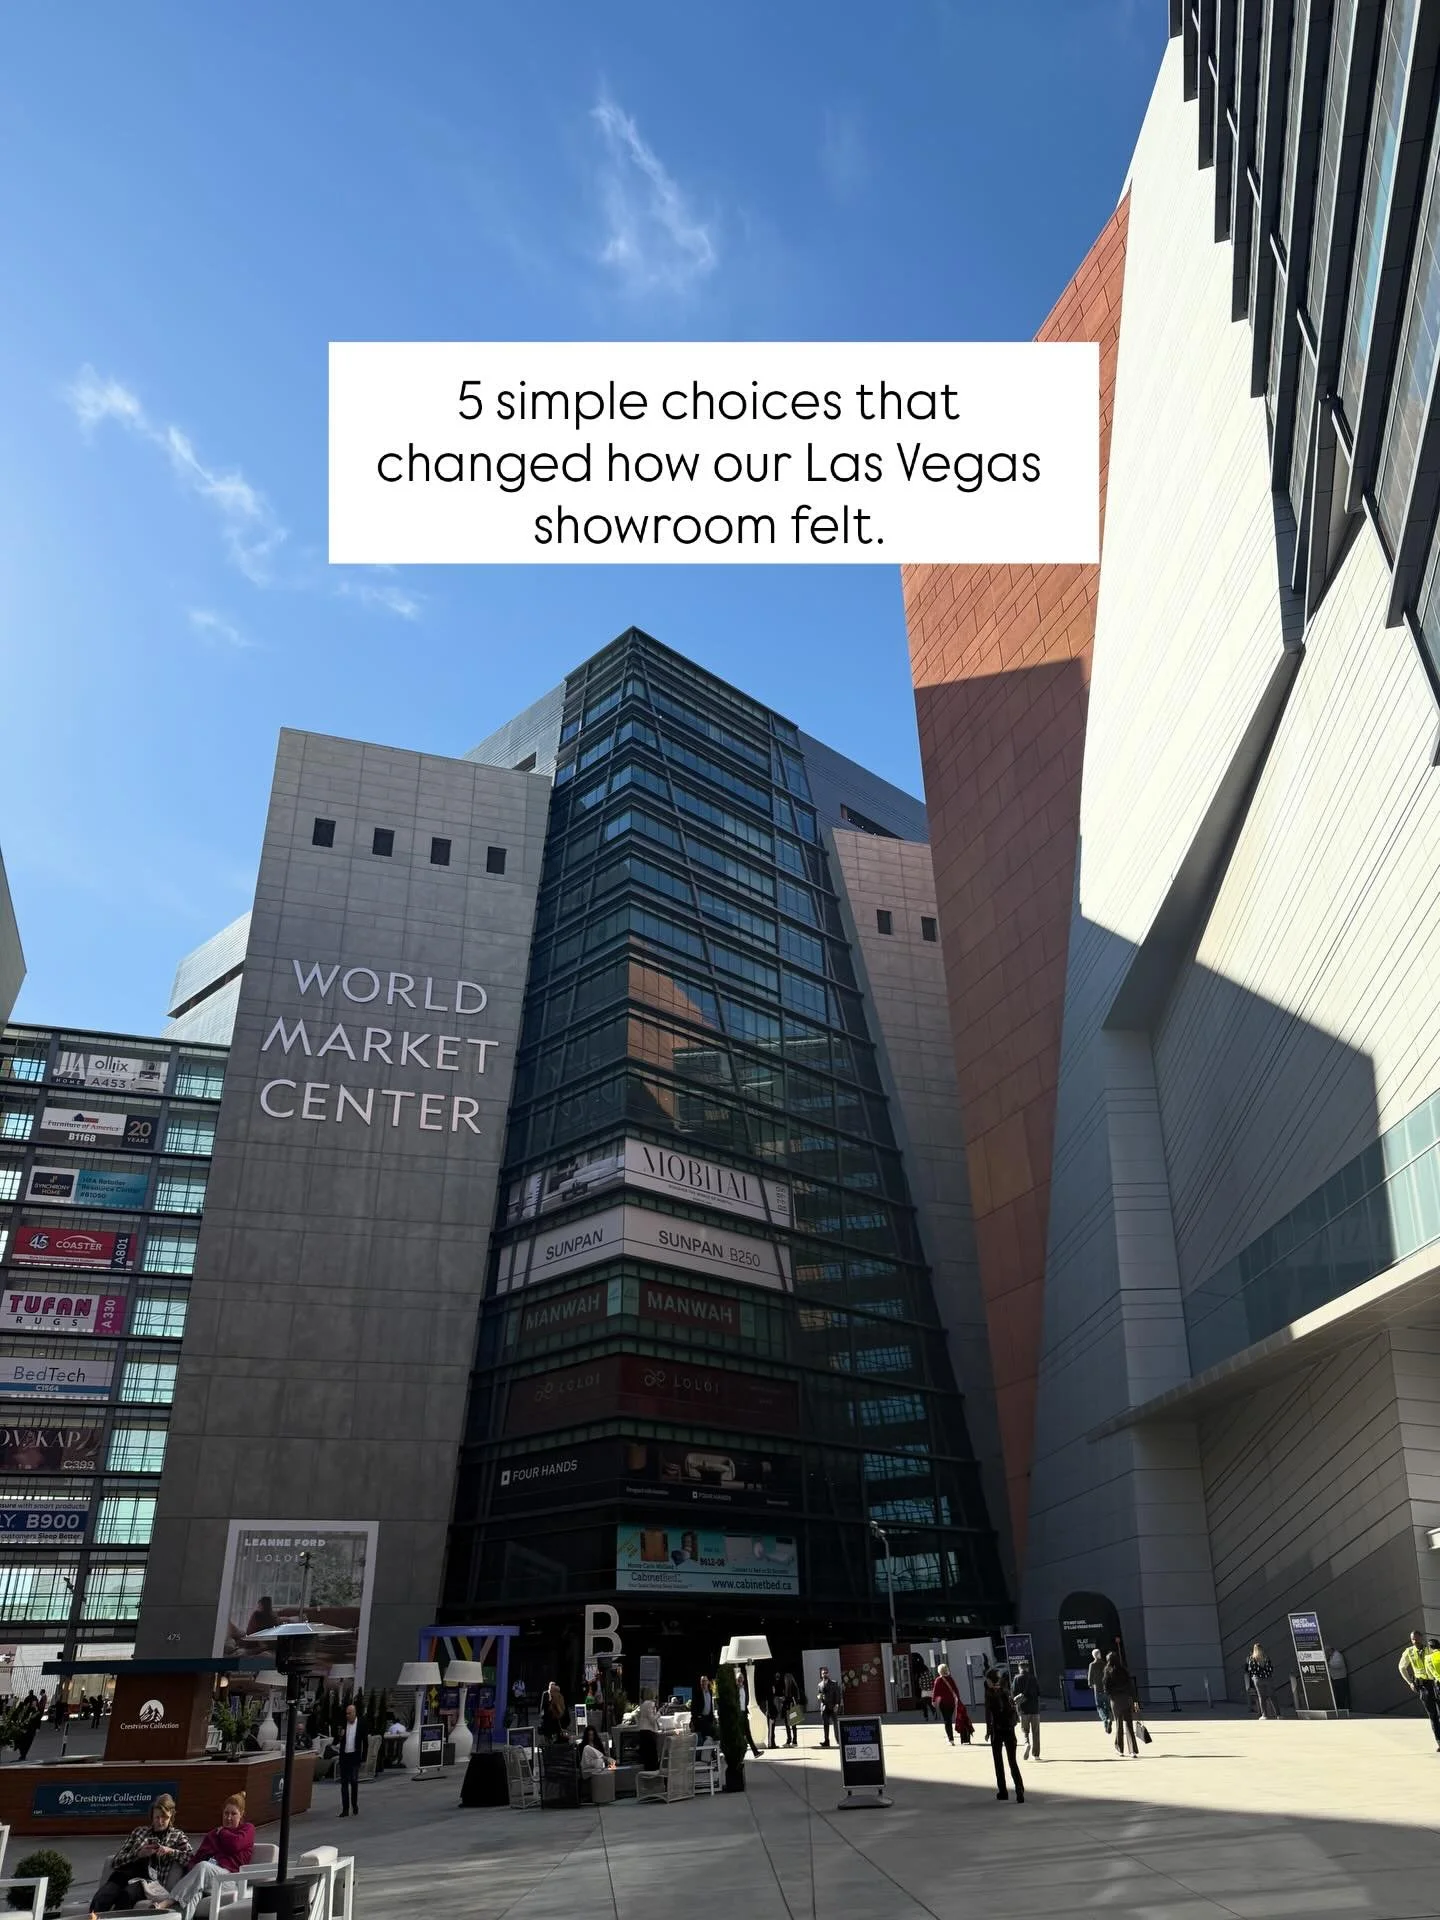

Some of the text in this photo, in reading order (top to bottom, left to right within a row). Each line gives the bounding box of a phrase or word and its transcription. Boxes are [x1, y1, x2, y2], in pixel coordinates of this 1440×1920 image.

[292, 959, 488, 1014] WORLD
[261, 1016, 499, 1074] MARKET
[90, 1077, 126, 1088] A453
[260, 1079, 481, 1134] CENTER
[47, 1120, 80, 1128] Furniture
[91, 1124, 119, 1132] America
[128, 1121, 152, 1137] 20
[68, 1132, 96, 1142] B1168
[33, 1182, 71, 1190] SYNCHRONY
[56, 1240, 102, 1251] COASTER
[114, 1238, 129, 1265] A801
[545, 1228, 604, 1261] SUNPAN
[658, 1230, 761, 1267] SUNPAN B250
[10, 1295, 92, 1316] TUFAN
[526, 1293, 600, 1331] MANWAH
[647, 1291, 733, 1324] MANWAH
[16, 1316, 78, 1327] RUGS
[14, 1366, 86, 1382] BedTech
[673, 1375, 719, 1395] LOLOI
[63, 1460, 95, 1469] C399
[512, 1459, 579, 1482] FOUR HANDS
[18, 1501, 33, 1509] with
[55, 1502, 86, 1511] products
[26, 1513, 80, 1529] B900
[38, 1532, 57, 1540] Sleep
[244, 1538, 326, 1547] LEANNE FORD
[584, 1603, 623, 1665] B
[120, 1722, 149, 1730] Crestview
[74, 1792, 152, 1804] Crestview Collection
